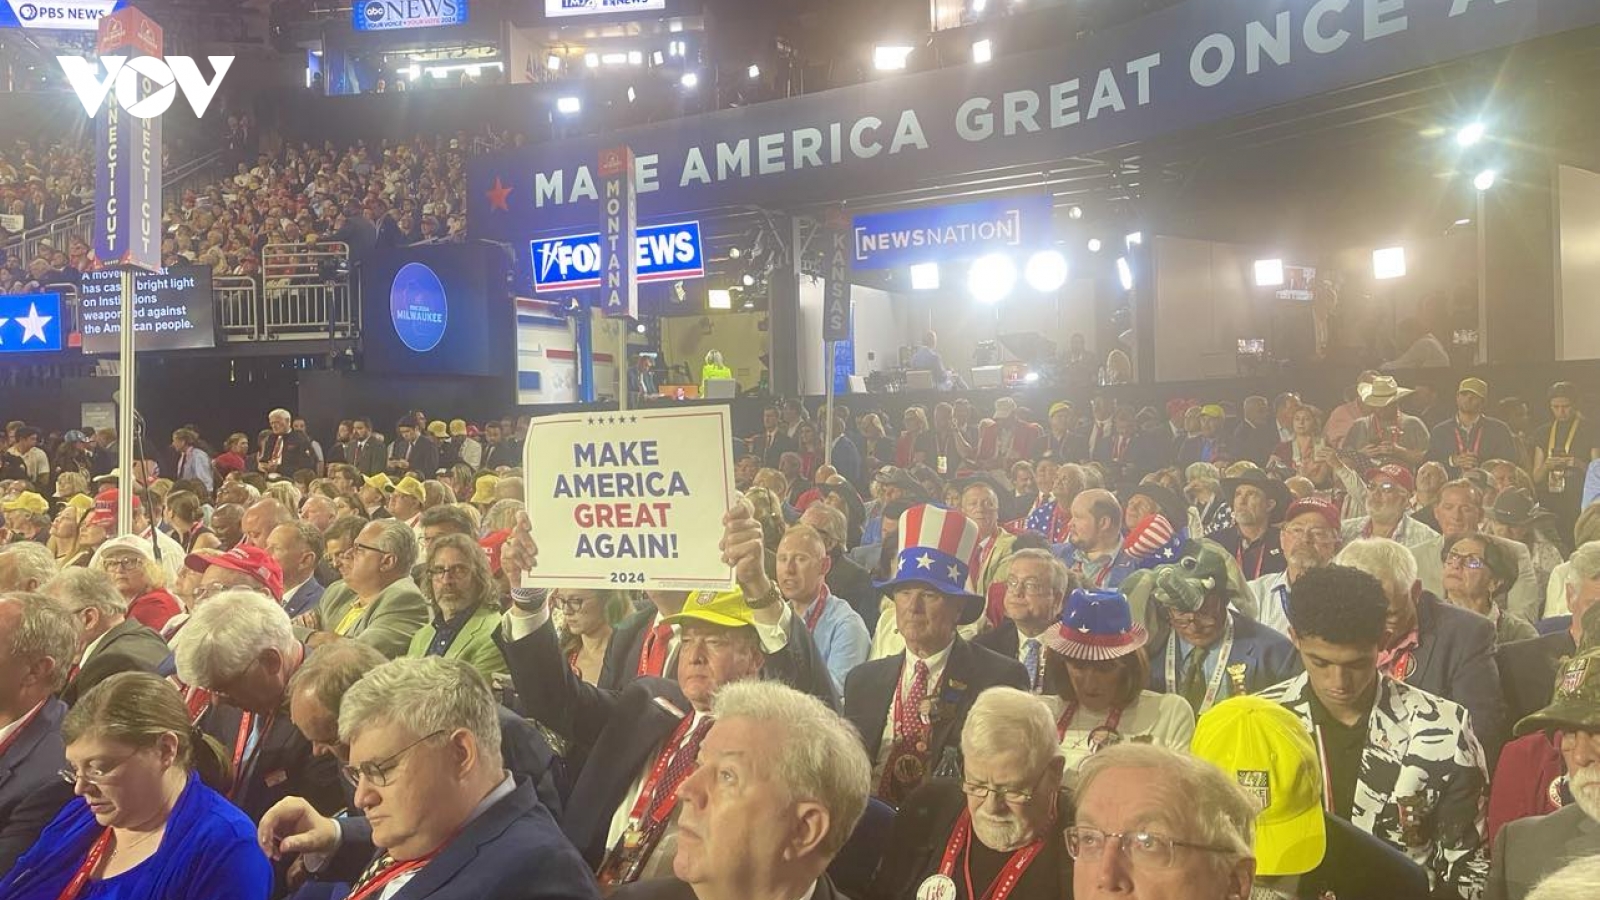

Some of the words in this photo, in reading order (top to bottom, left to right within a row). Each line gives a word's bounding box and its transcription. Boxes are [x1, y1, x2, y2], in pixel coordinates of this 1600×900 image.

[39, 7, 64, 19] PBS
[68, 8, 105, 20] NEWS
[386, 0, 456, 20] NEWS
[535, 153, 660, 207] MAE
[679, 109, 928, 187] AMERICA
[956, 53, 1160, 141] GREAT
[1189, 0, 1408, 87] ONCE
[607, 180, 621, 306] MONTANA
[637, 231, 695, 267] EWS
[82, 284, 101, 294] has
[104, 283, 122, 292] cas
[137, 279, 168, 291] bright
[171, 277, 194, 290] light
[831, 233, 846, 330] KANSAS
[83, 298, 96, 307] on
[147, 306, 187, 318] against
[85, 324, 100, 335] the
[104, 322, 152, 333] Amcan
[155, 319, 194, 332] people.
[397, 310, 443, 322] MILWAUKEE
[573, 441, 660, 468] MAKE
[553, 471, 690, 498] AMERICA
[573, 502, 672, 528] GREAT
[575, 533, 679, 559] AGAIN!
[610, 572, 645, 583] 2024
